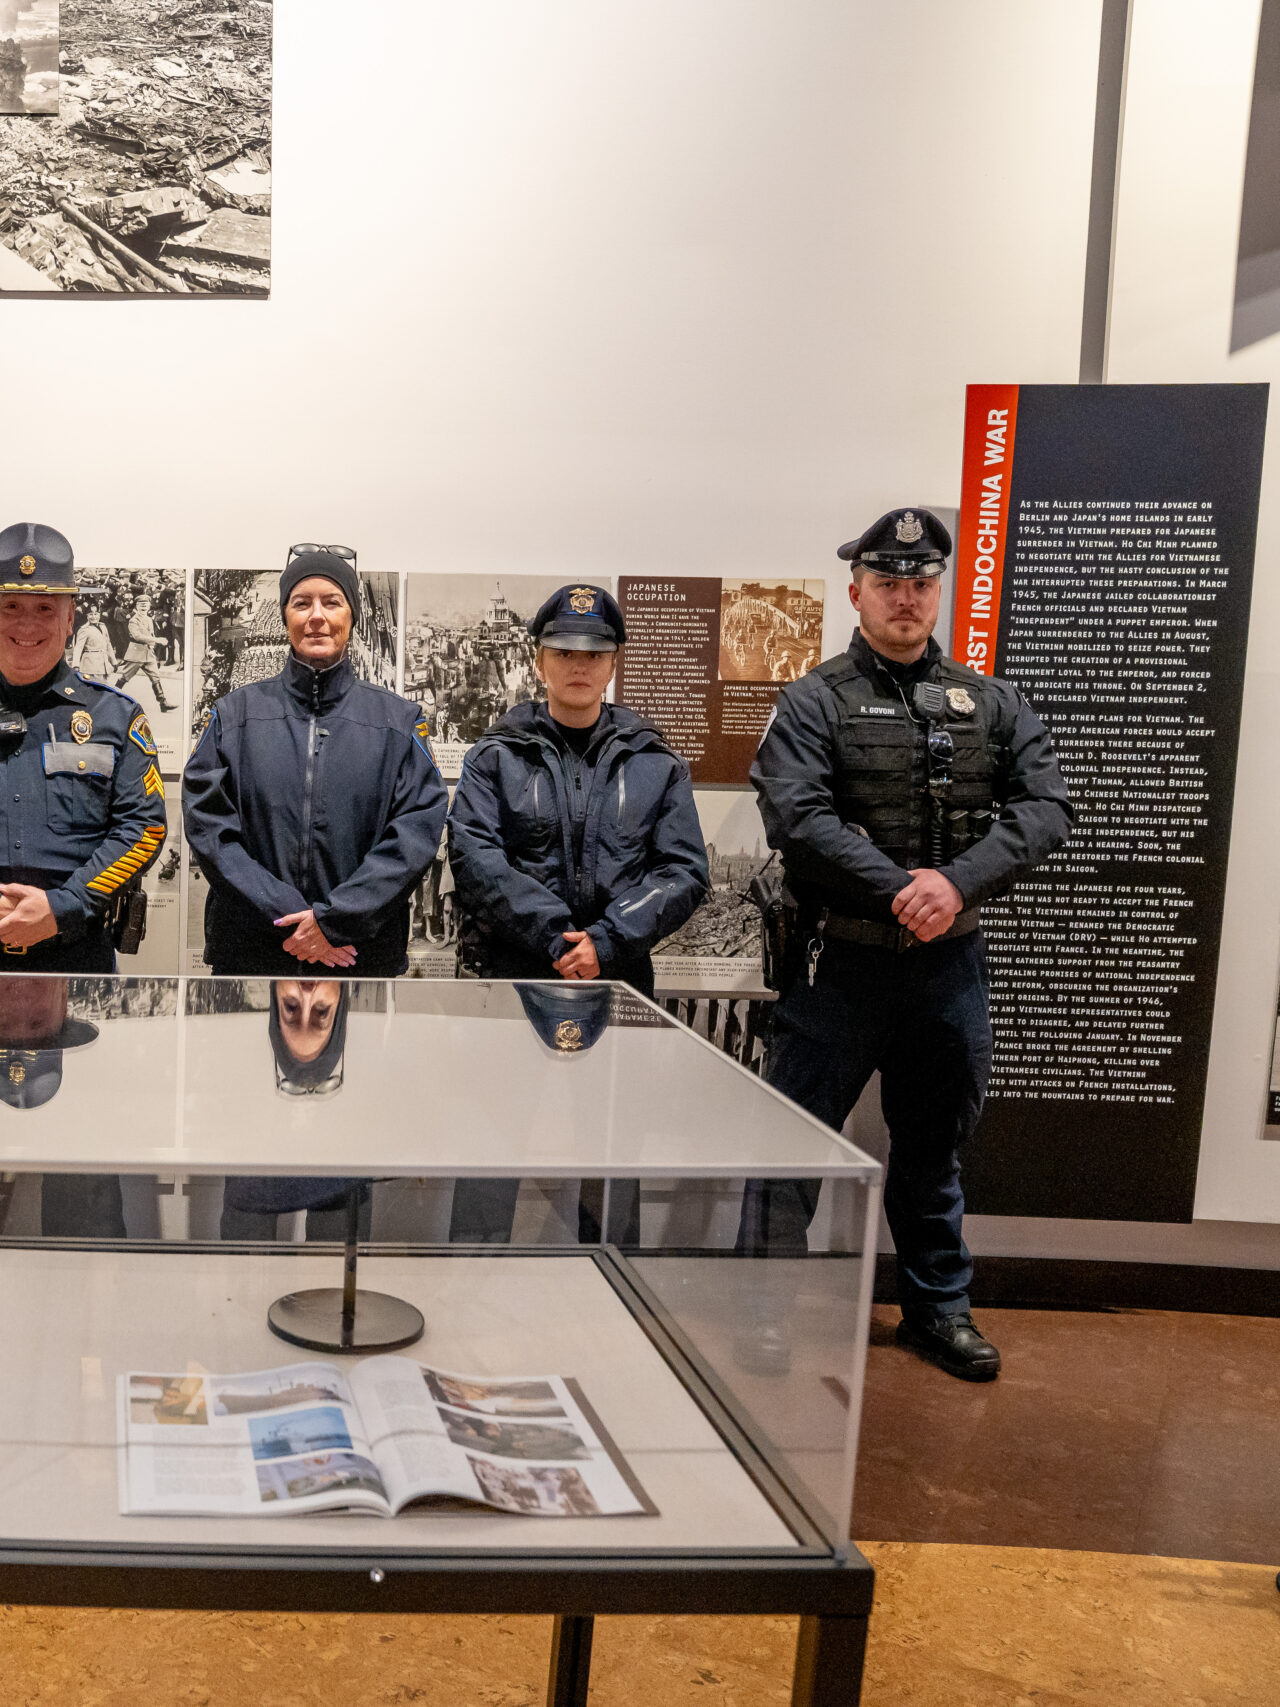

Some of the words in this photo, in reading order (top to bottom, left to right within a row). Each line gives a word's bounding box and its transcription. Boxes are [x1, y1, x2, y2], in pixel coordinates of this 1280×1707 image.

[984, 408, 1009, 466] WAR
[1052, 500, 1082, 508] ALLIES
[1019, 513, 1049, 521] BERLIN
[1072, 513, 1106, 521] JAPAN'S
[1019, 526, 1044, 534] 1945,
[1067, 526, 1106, 534] VIETMINH
[1174, 527, 1215, 535] JAPANESE
[971, 473, 1003, 618] INDOCHINA
[1079, 539, 1117, 547] VIETNAM.
[627, 584, 675, 592] JAPANESE
[627, 593, 686, 601] OCCUPATION
[966, 626, 989, 676] RST
[860, 706, 868, 714] R.
[869, 706, 895, 715] GOVONI
[1016, 906, 1031, 914] THE
[1035, 907, 1072, 915] VIETMINH
[1021, 919, 1054, 927] VIETNAM
[1126, 922, 1174, 931] DEMOCRATIC
